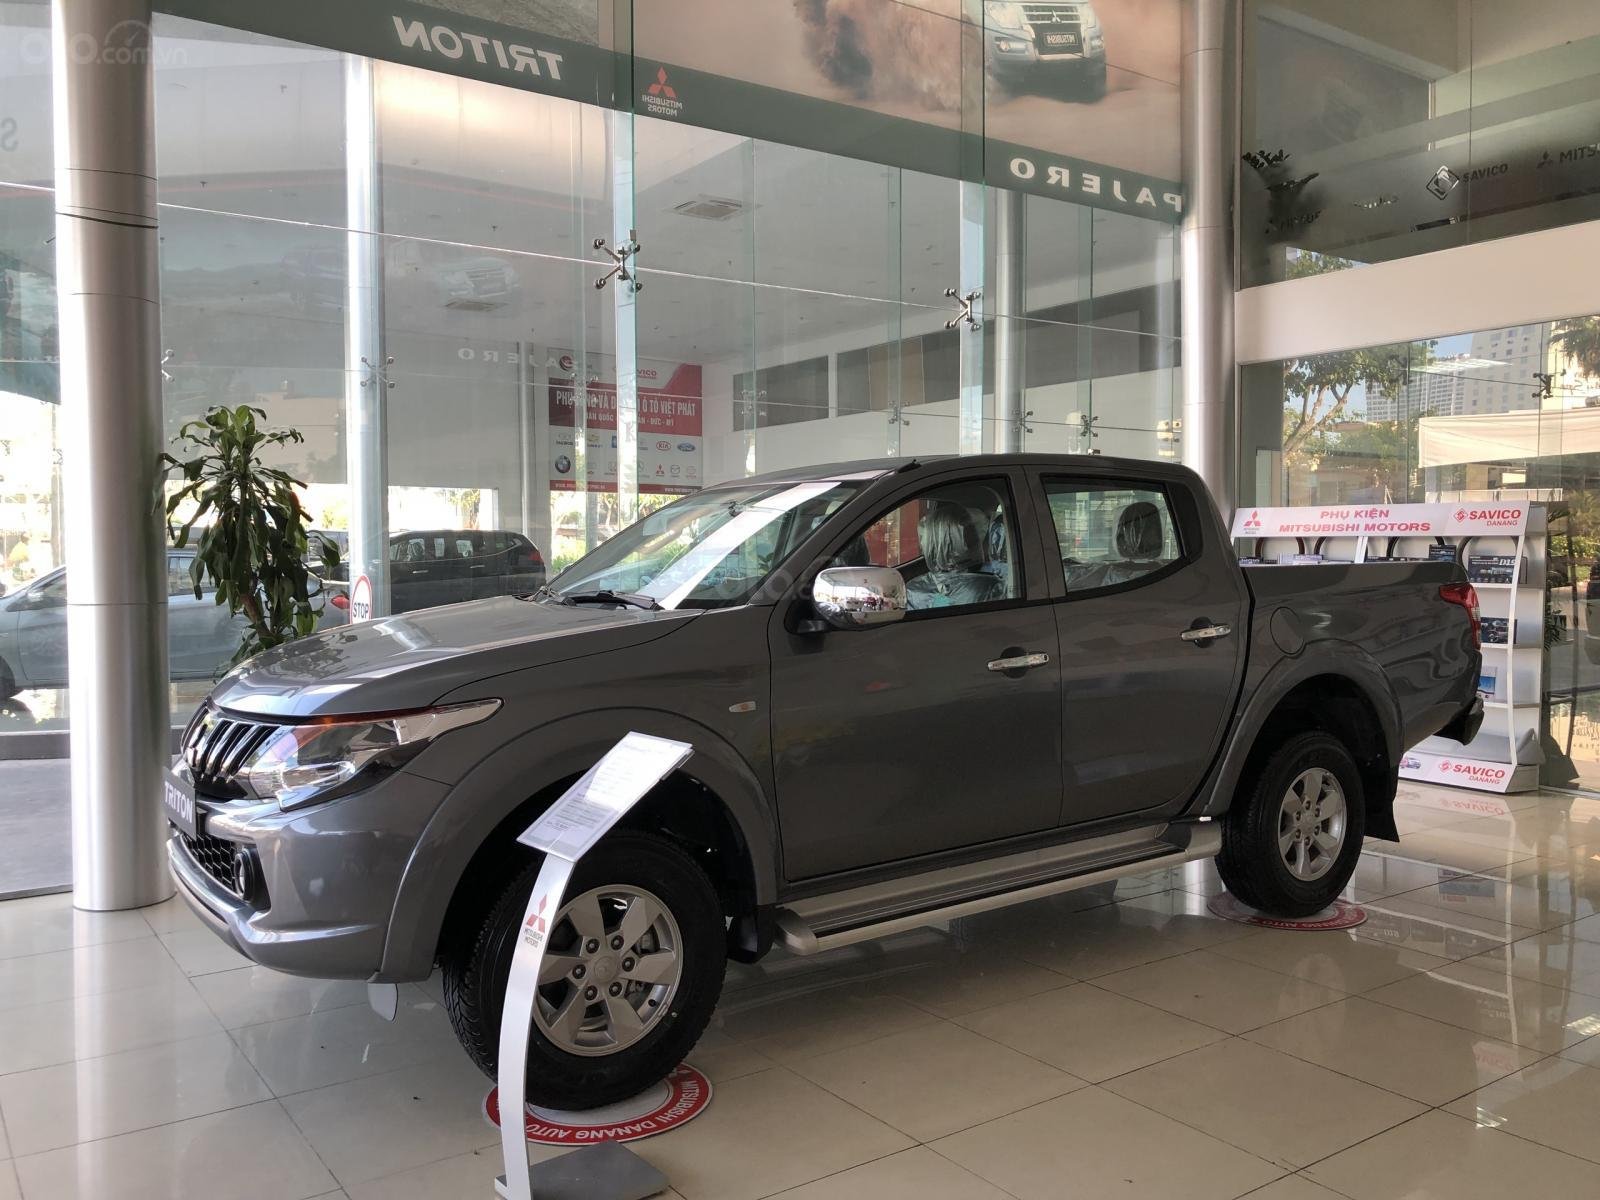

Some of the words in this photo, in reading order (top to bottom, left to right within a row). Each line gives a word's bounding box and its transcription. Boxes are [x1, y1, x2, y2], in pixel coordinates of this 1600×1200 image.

[1463, 163, 1509, 184] SAVICO
[1320, 509, 1350, 520] PHỤ
[1354, 507, 1390, 519] KIỆN
[1469, 509, 1521, 520] SAVICO
[1279, 523, 1360, 533] MITSUBISHI
[1364, 522, 1431, 532] MOTORS
[352, 602, 369, 619] STOP
[1453, 764, 1506, 779] SAVICO
[1468, 775, 1500, 785] DANANG
[164, 780, 193, 824] TRITON
[655, 1080, 700, 1124] MITSUBISHI
[526, 1123, 572, 1139] AUTO
[575, 1119, 657, 1140] DANANG
